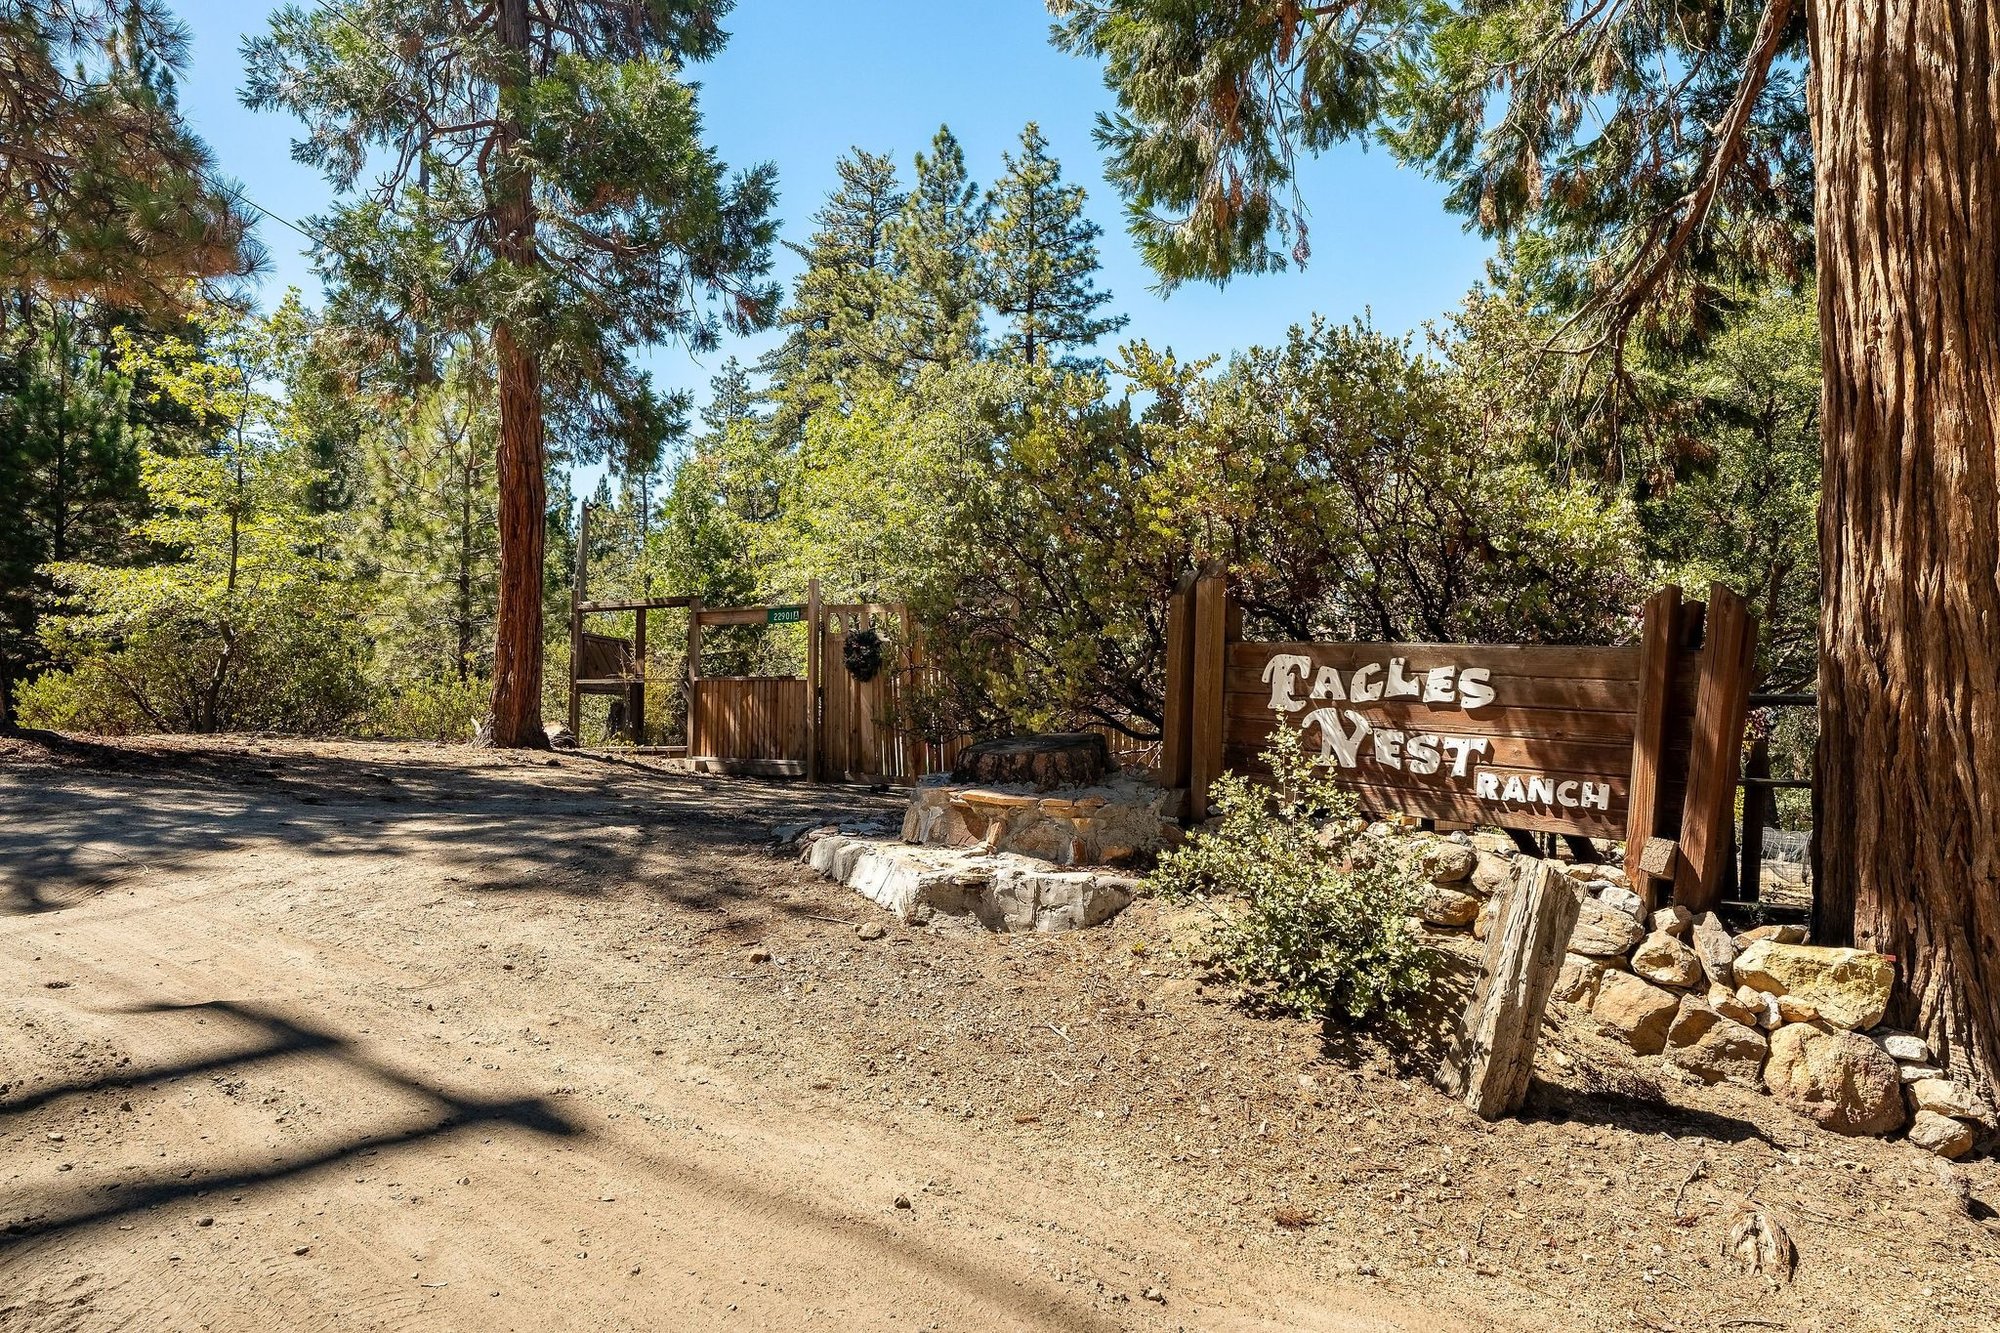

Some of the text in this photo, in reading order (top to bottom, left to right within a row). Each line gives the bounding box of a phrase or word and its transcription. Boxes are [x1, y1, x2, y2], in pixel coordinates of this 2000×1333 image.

[1262, 653, 1497, 713] EAGLES
[1302, 707, 1490, 777] NEST
[1476, 771, 1611, 811] RANCH
